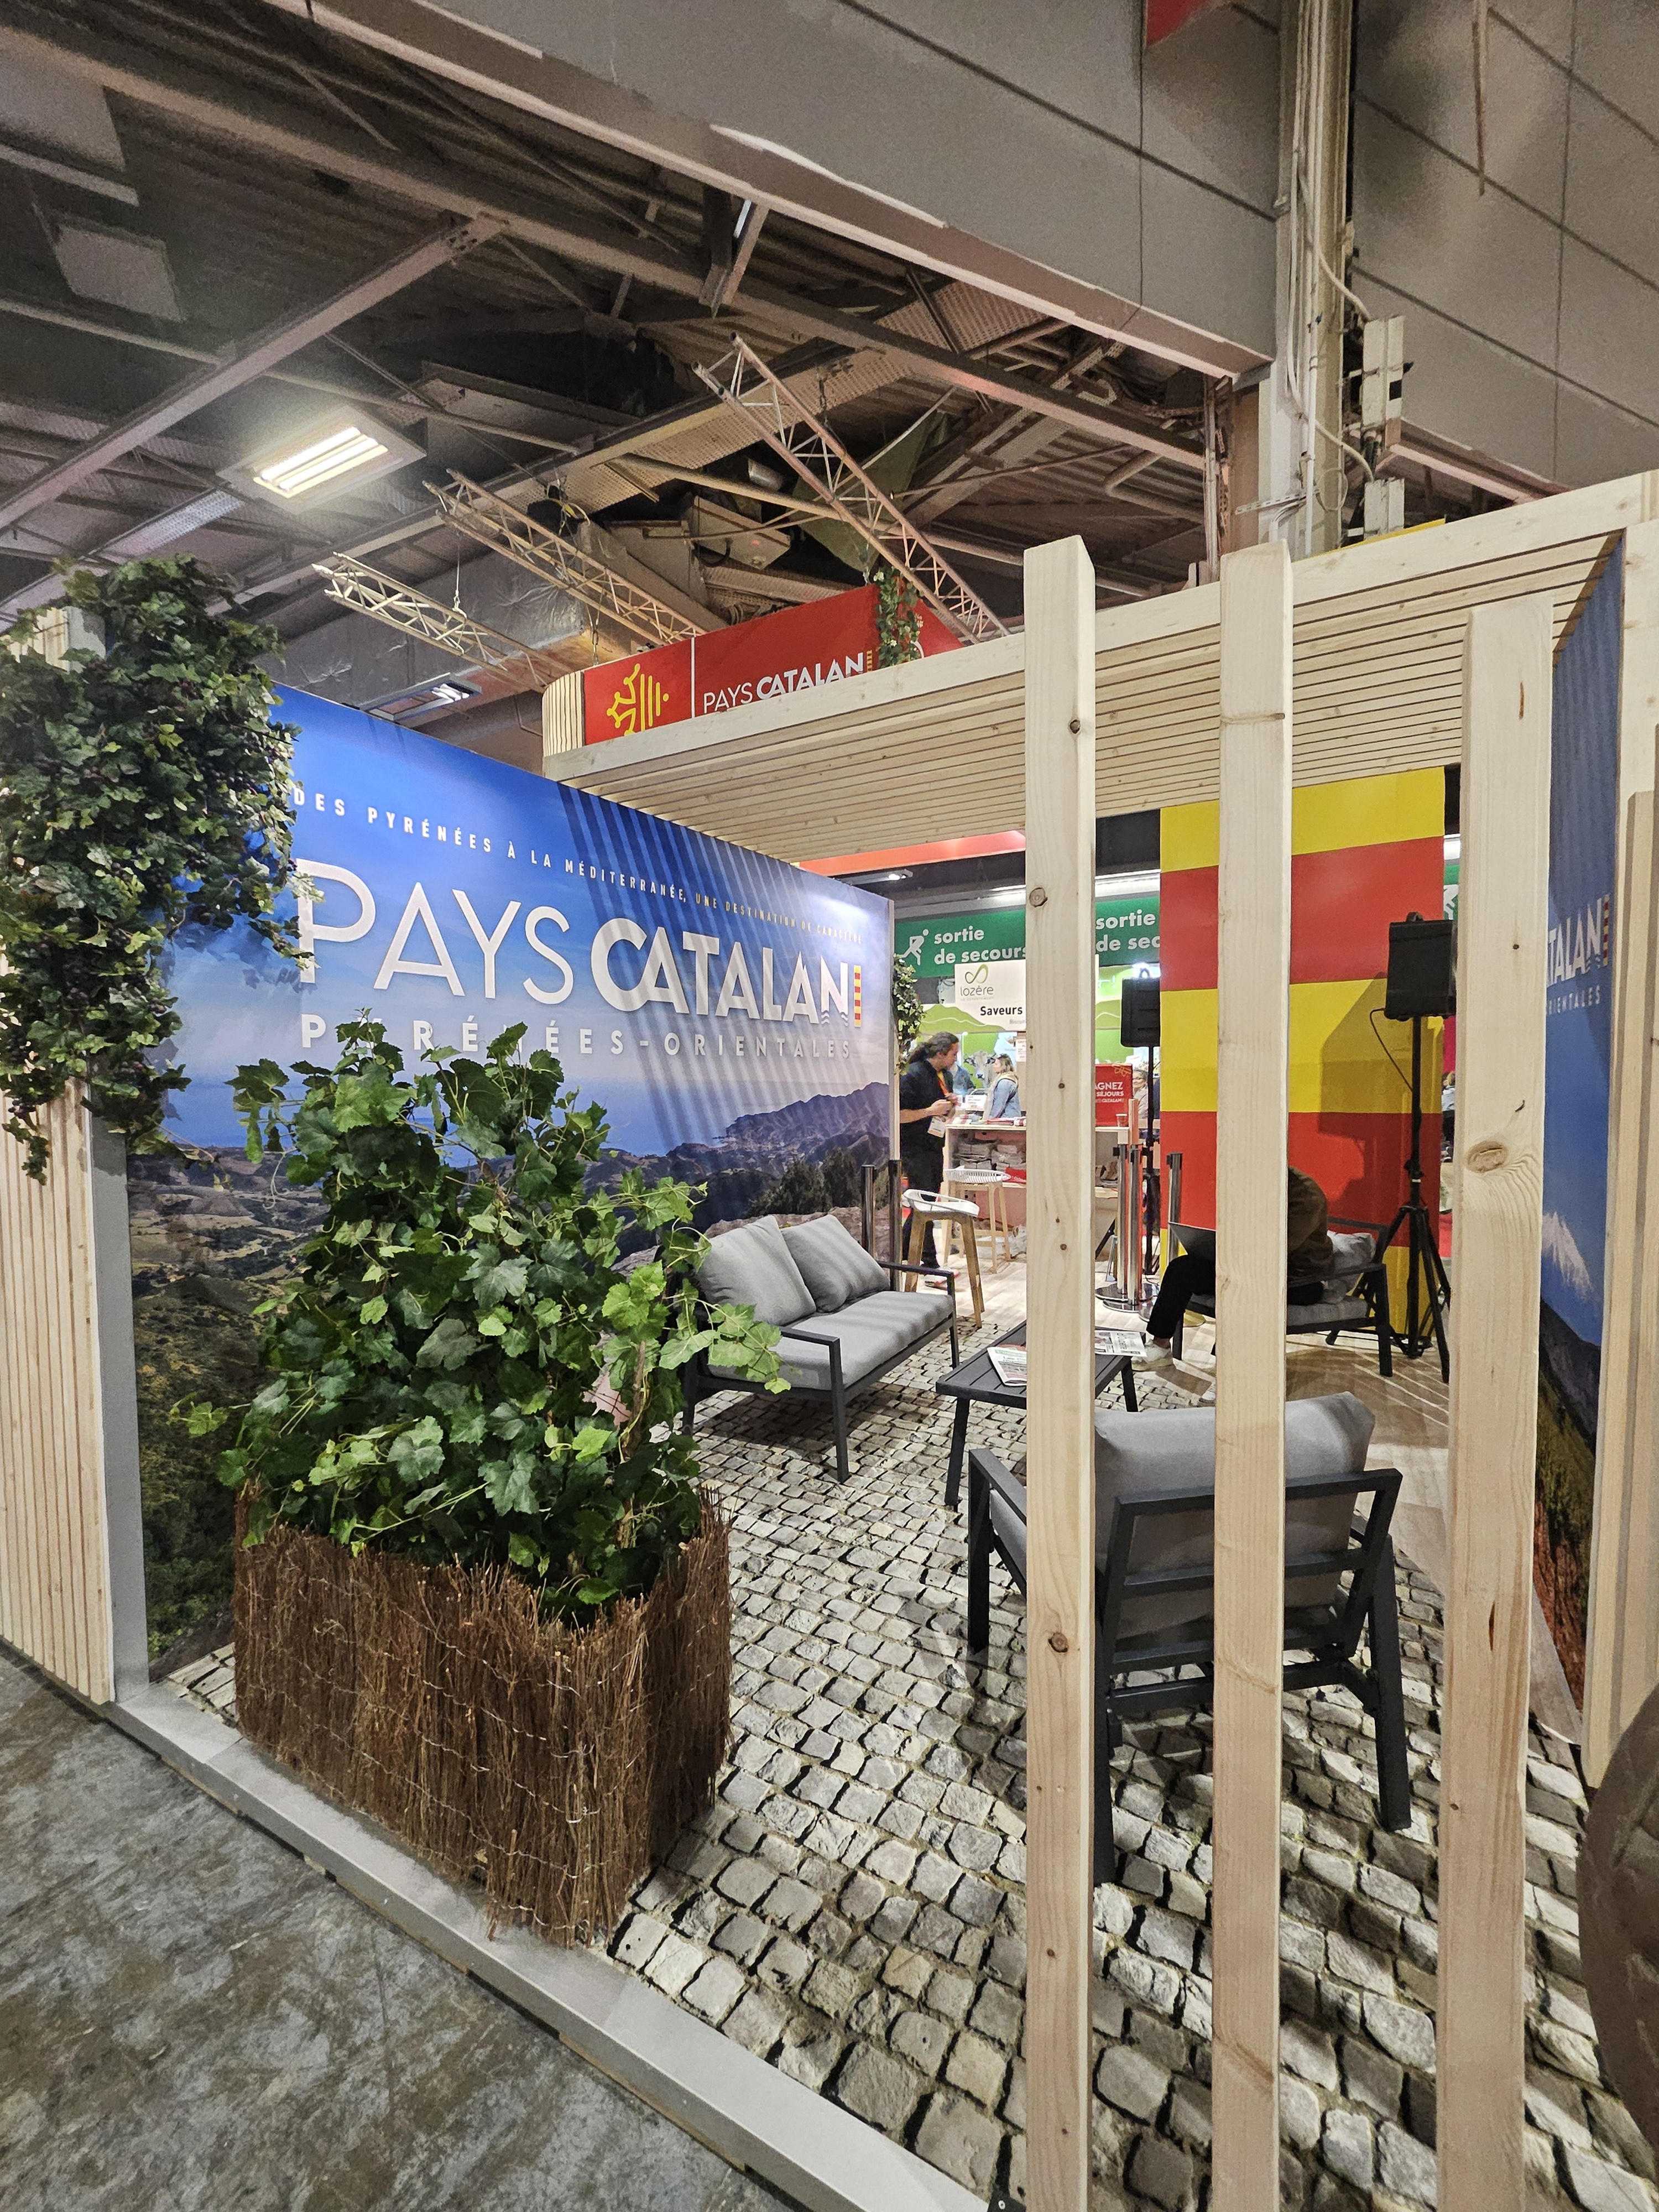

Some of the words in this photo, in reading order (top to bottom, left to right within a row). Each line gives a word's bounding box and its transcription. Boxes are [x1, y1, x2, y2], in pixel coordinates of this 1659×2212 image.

[703, 682, 753, 713] PAYS
[756, 652, 864, 700] CATALAN
[294, 787, 345, 816] DES
[367, 806, 491, 852] PYRÉNÉES
[507, 841, 515, 859] À
[531, 850, 551, 868] LA
[565, 859, 686, 902] MÉDITERRANÉE,
[696, 893, 717, 909] UNE
[726, 901, 795, 927] DESTINATION
[801, 922, 811, 932] DE
[1095, 909, 1156, 930] sortie
[296, 858, 575, 1005] PAYS
[590, 917, 849, 1025] CATALAN
[933, 925, 984, 945] sortie
[1095, 934, 1121, 952] de
[934, 948, 956, 964] de
[960, 985, 994, 997] lozère
[980, 1006, 1023, 1016] Saveurs
[301, 1014, 850, 1058] PRÉÉES-ORIENTALES
